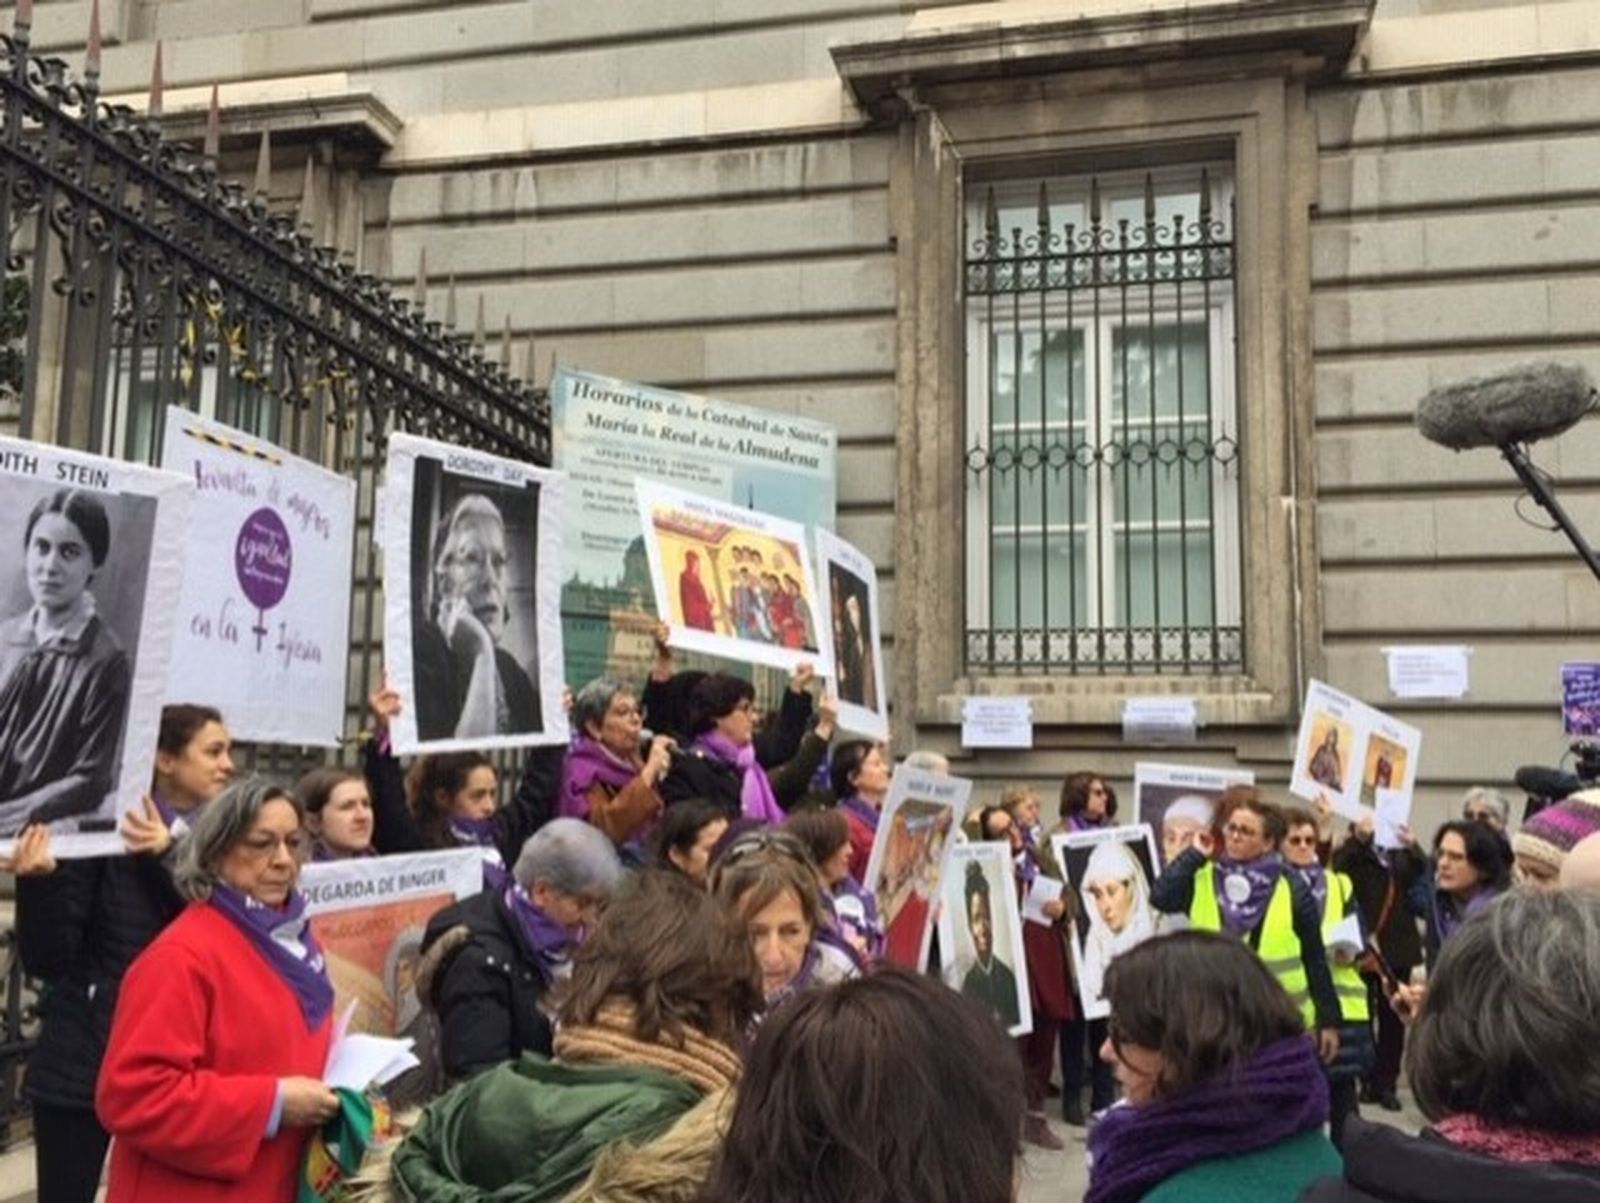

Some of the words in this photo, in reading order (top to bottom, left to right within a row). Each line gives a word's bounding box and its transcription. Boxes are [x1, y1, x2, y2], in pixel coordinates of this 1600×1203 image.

[573, 381, 663, 413] Horarios
[667, 403, 682, 415] de
[686, 405, 698, 419] la
[702, 408, 768, 434] Catedral
[770, 424, 785, 437] de
[788, 426, 829, 447] Santa
[585, 411, 639, 435] María
[642, 424, 655, 438] la
[659, 426, 697, 446] Real
[699, 435, 715, 449] de
[718, 438, 731, 453] la
[732, 439, 819, 468] Almudena
[56, 461, 109, 488] STEIN
[378, 877, 395, 895] DE
[398, 868, 447, 889] BINGER
